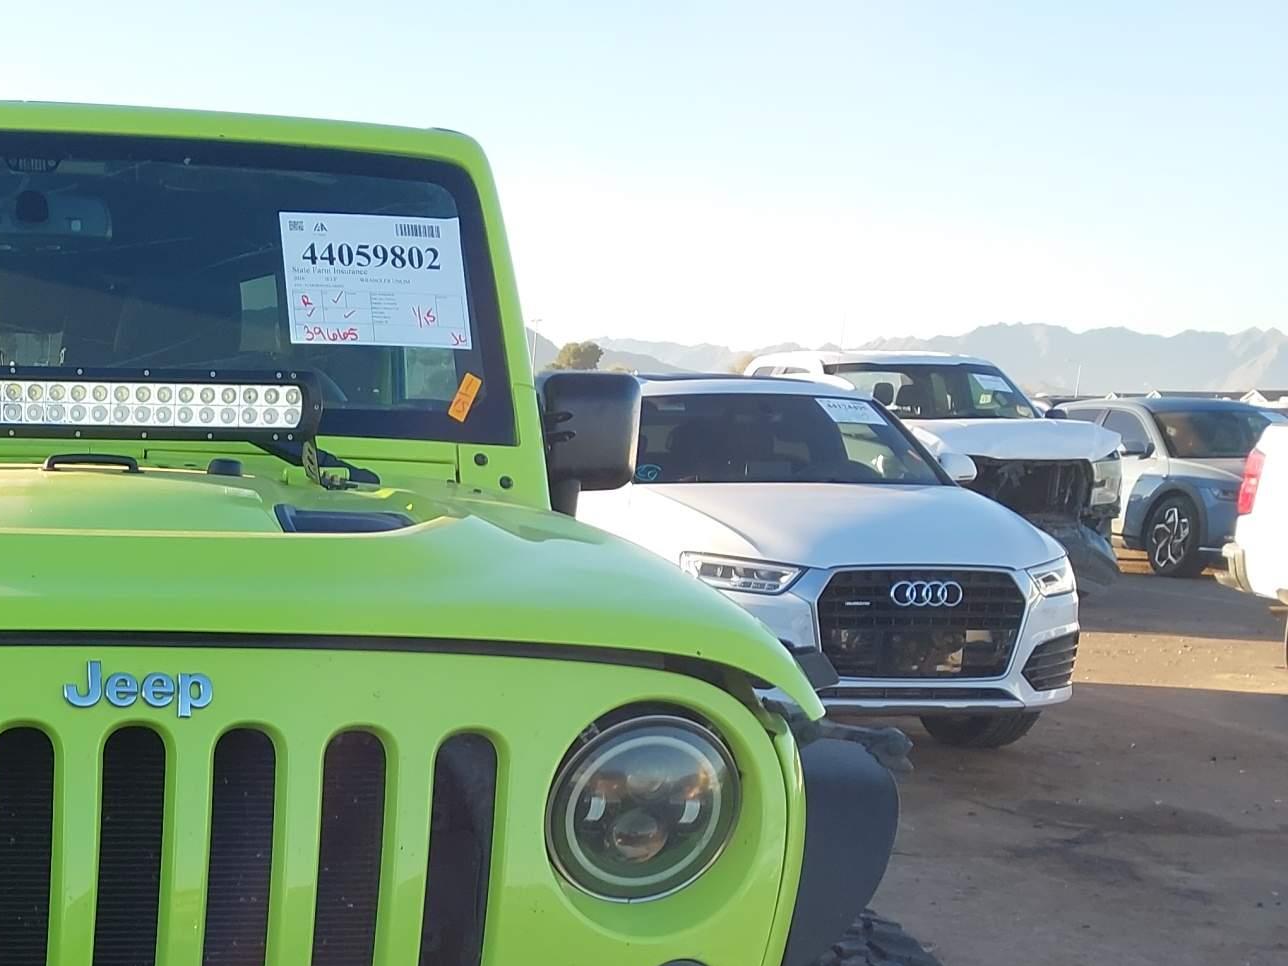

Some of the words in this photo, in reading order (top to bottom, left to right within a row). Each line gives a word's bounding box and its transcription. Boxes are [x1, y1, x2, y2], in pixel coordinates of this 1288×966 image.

[302, 242, 441, 270] 44059802
[291, 266, 310, 274] State
[333, 267, 368, 276] Insurance
[63, 660, 213, 718] Jeep
